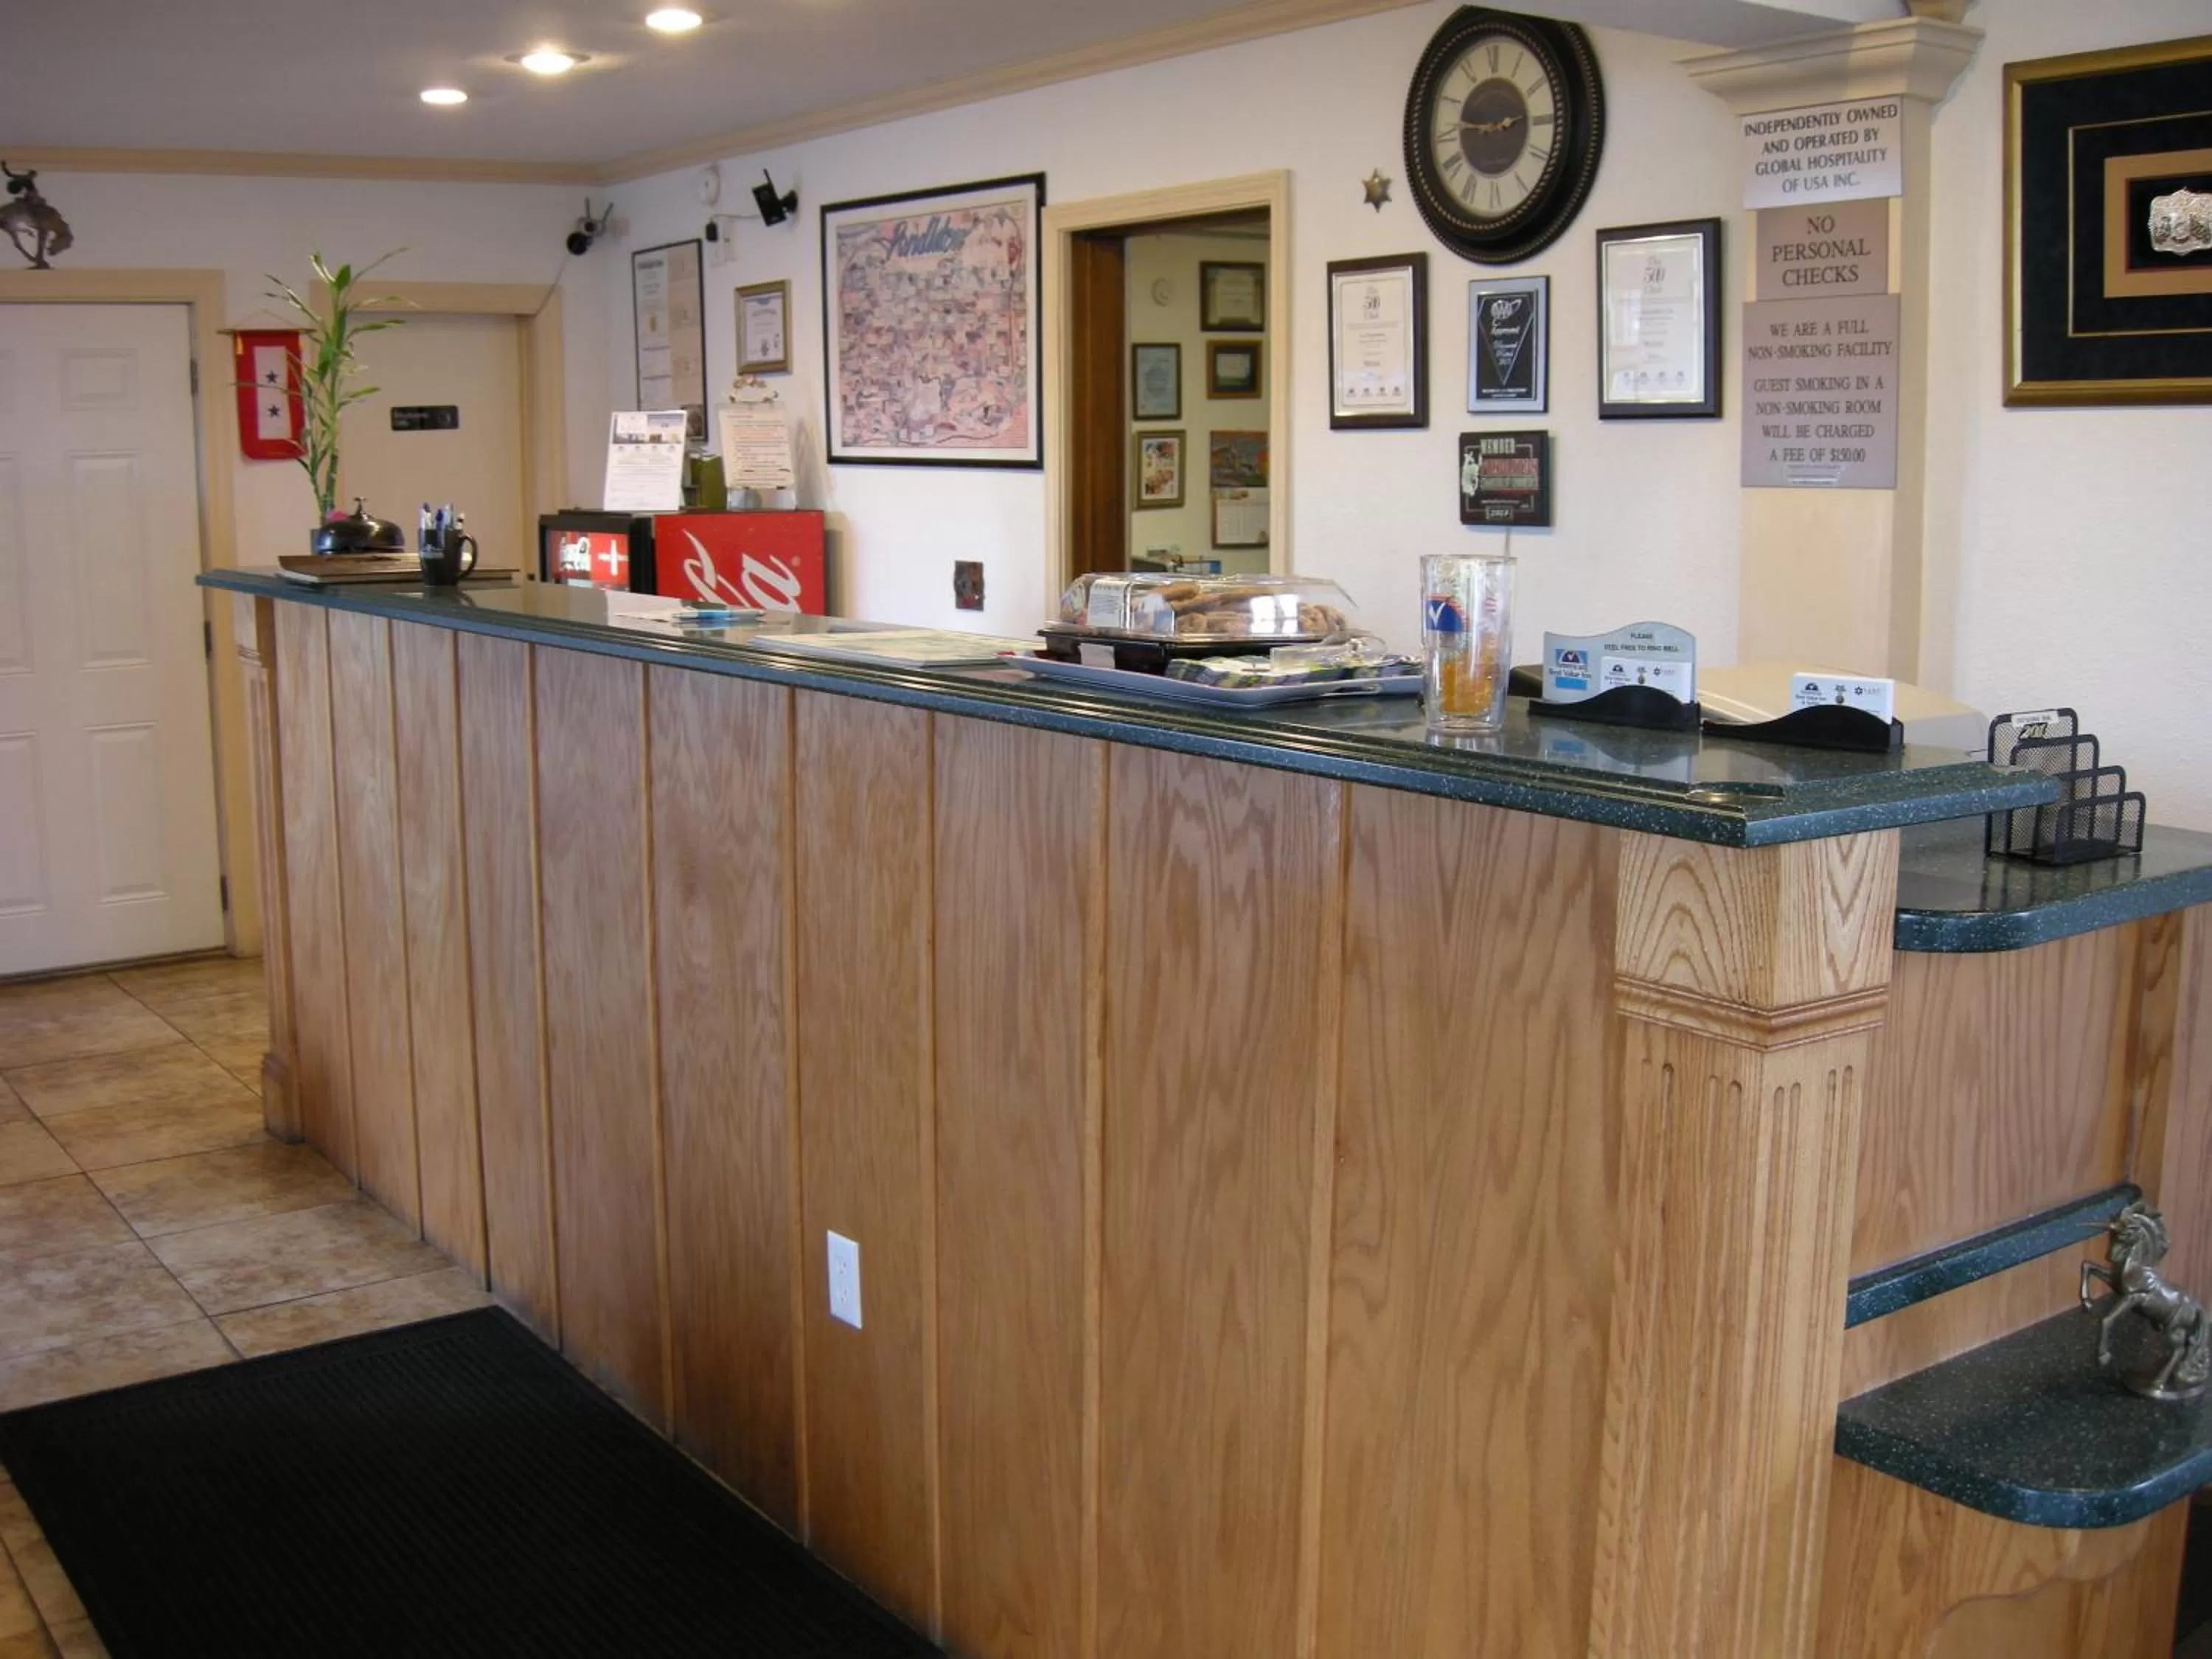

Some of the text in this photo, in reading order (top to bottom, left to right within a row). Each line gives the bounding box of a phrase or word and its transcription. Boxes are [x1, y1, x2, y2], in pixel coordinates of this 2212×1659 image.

[1745, 104, 1898, 136] INDEPENDENTLY OWNED
[1762, 128, 1879, 154] AND OPERATED BY
[1755, 147, 1888, 175] GLOBAL HOSPITALITY
[1781, 172, 1860, 193] OF USA INC.
[1807, 215, 1835, 235] NO
[1772, 239, 1871, 262] PERSONAL
[1782, 265, 1860, 287] CHECKS
[1770, 319, 1869, 337] WE ARE A FULL
[1747, 341, 1892, 360] NON-SMOKING FACILITY
[1754, 375, 1884, 392] GUEST SMOKING IN A
[1845, 399, 1882, 414] ROOM
[1761, 423, 1875, 439] WILL BE CHARGED
[1769, 448, 1778, 462] A
[1783, 448, 1806, 462] FEE
[1809, 448, 1826, 462] OF
